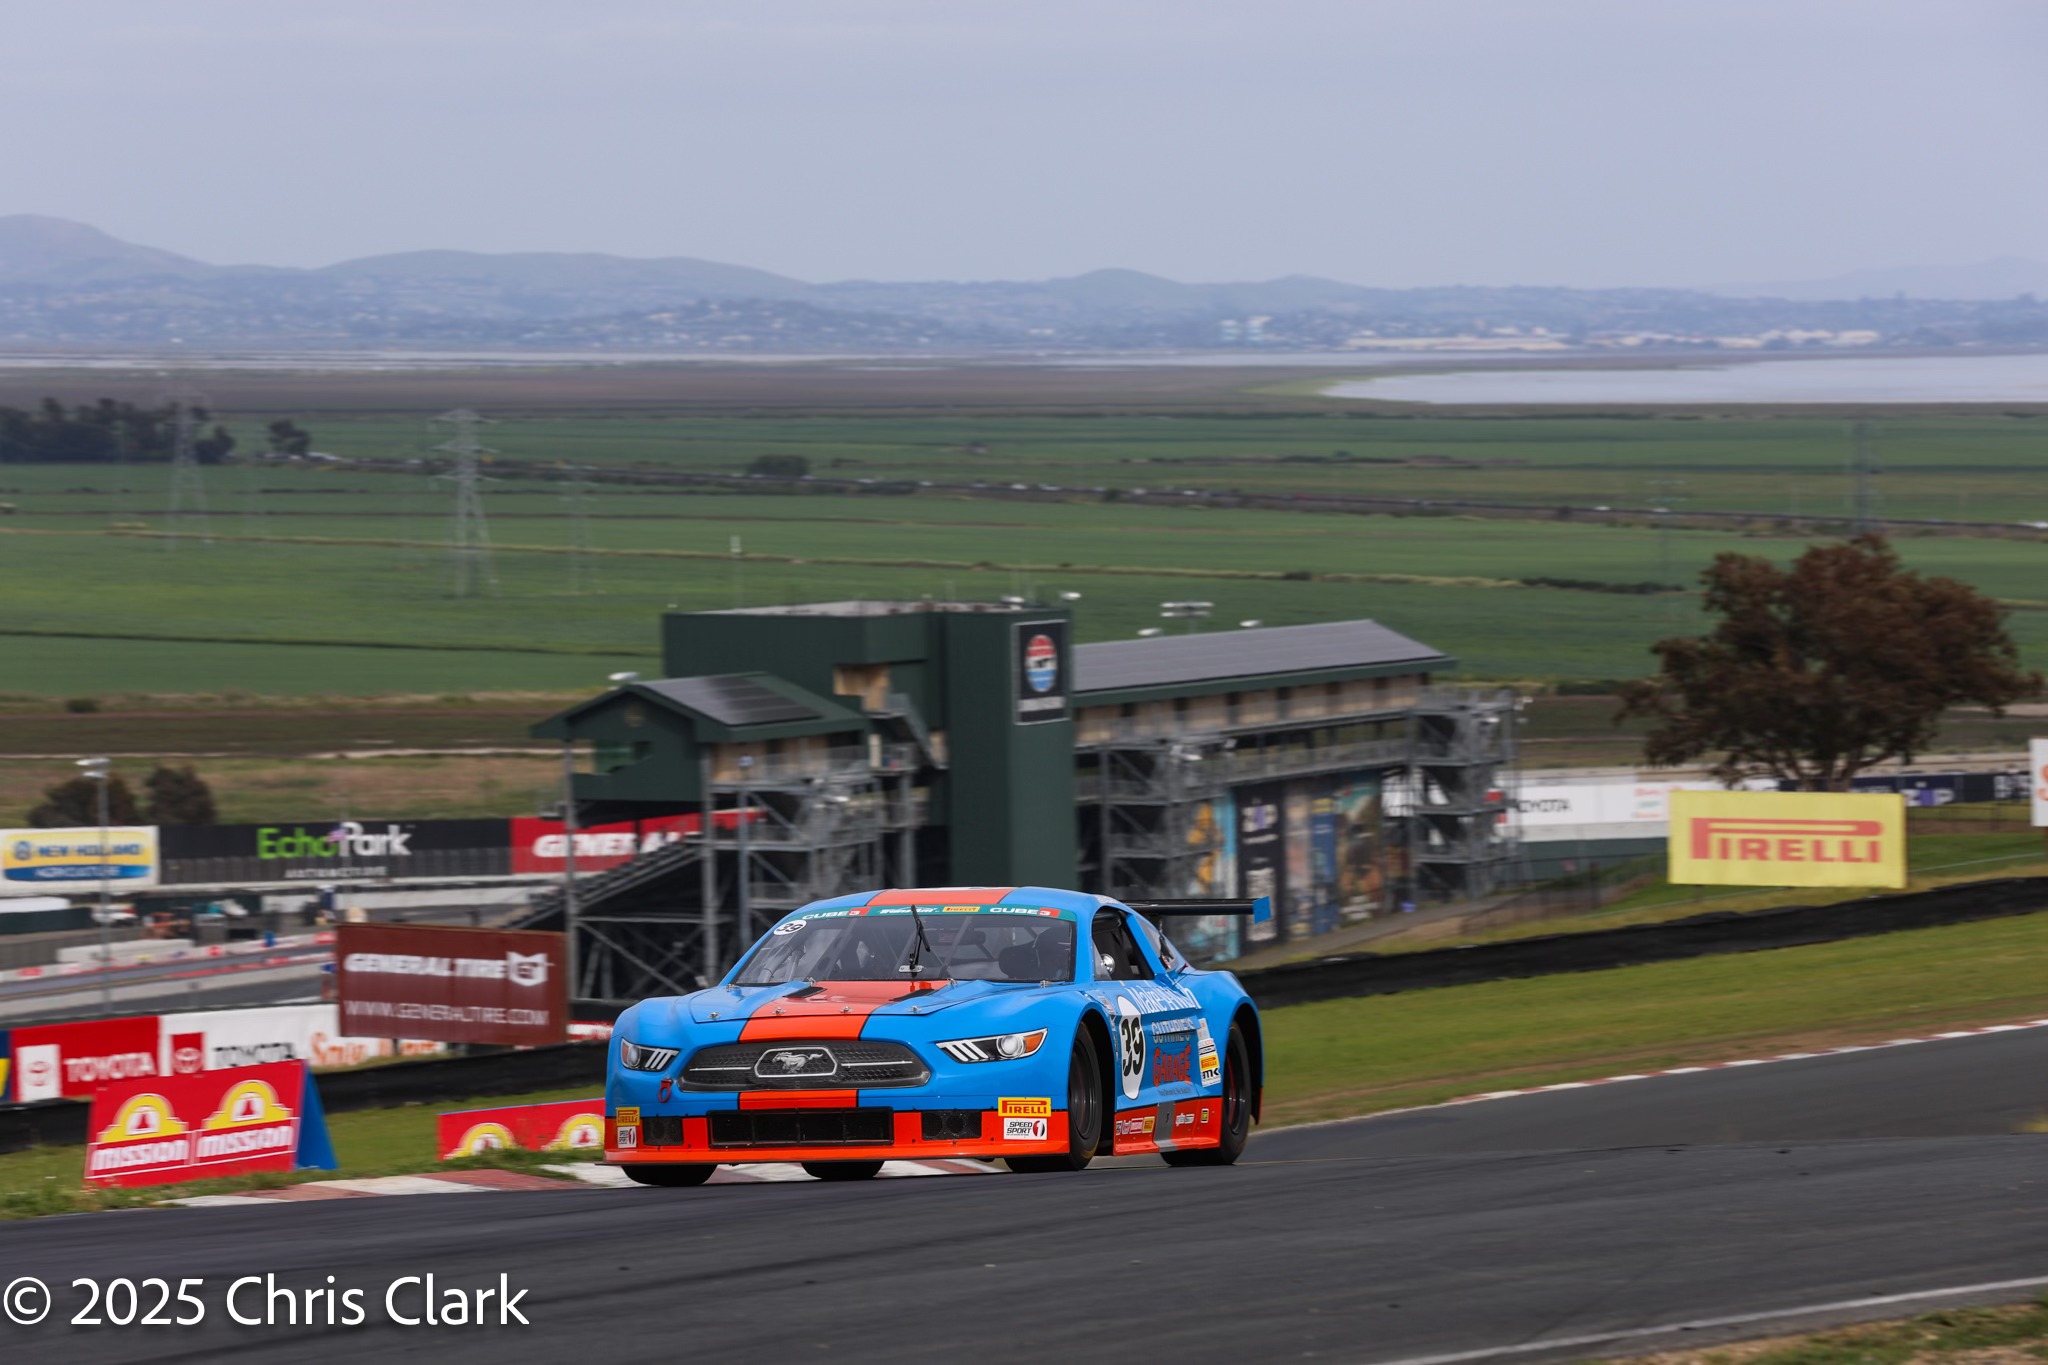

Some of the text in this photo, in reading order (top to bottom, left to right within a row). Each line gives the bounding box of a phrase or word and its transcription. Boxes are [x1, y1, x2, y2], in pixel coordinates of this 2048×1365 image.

[256, 822, 412, 859] EchoPark
[1690, 818, 1884, 863] PIRELLI
[776, 922, 804, 933] 39
[344, 953, 507, 979] GENERAL TIRE
[214, 1042, 297, 1069] TOYOTA
[1121, 1016, 1145, 1077] 39
[63, 1052, 157, 1083] TOYOTA
[1153, 1046, 1192, 1087] GARAGE
[1002, 1100, 1047, 1113] PIRELLI
